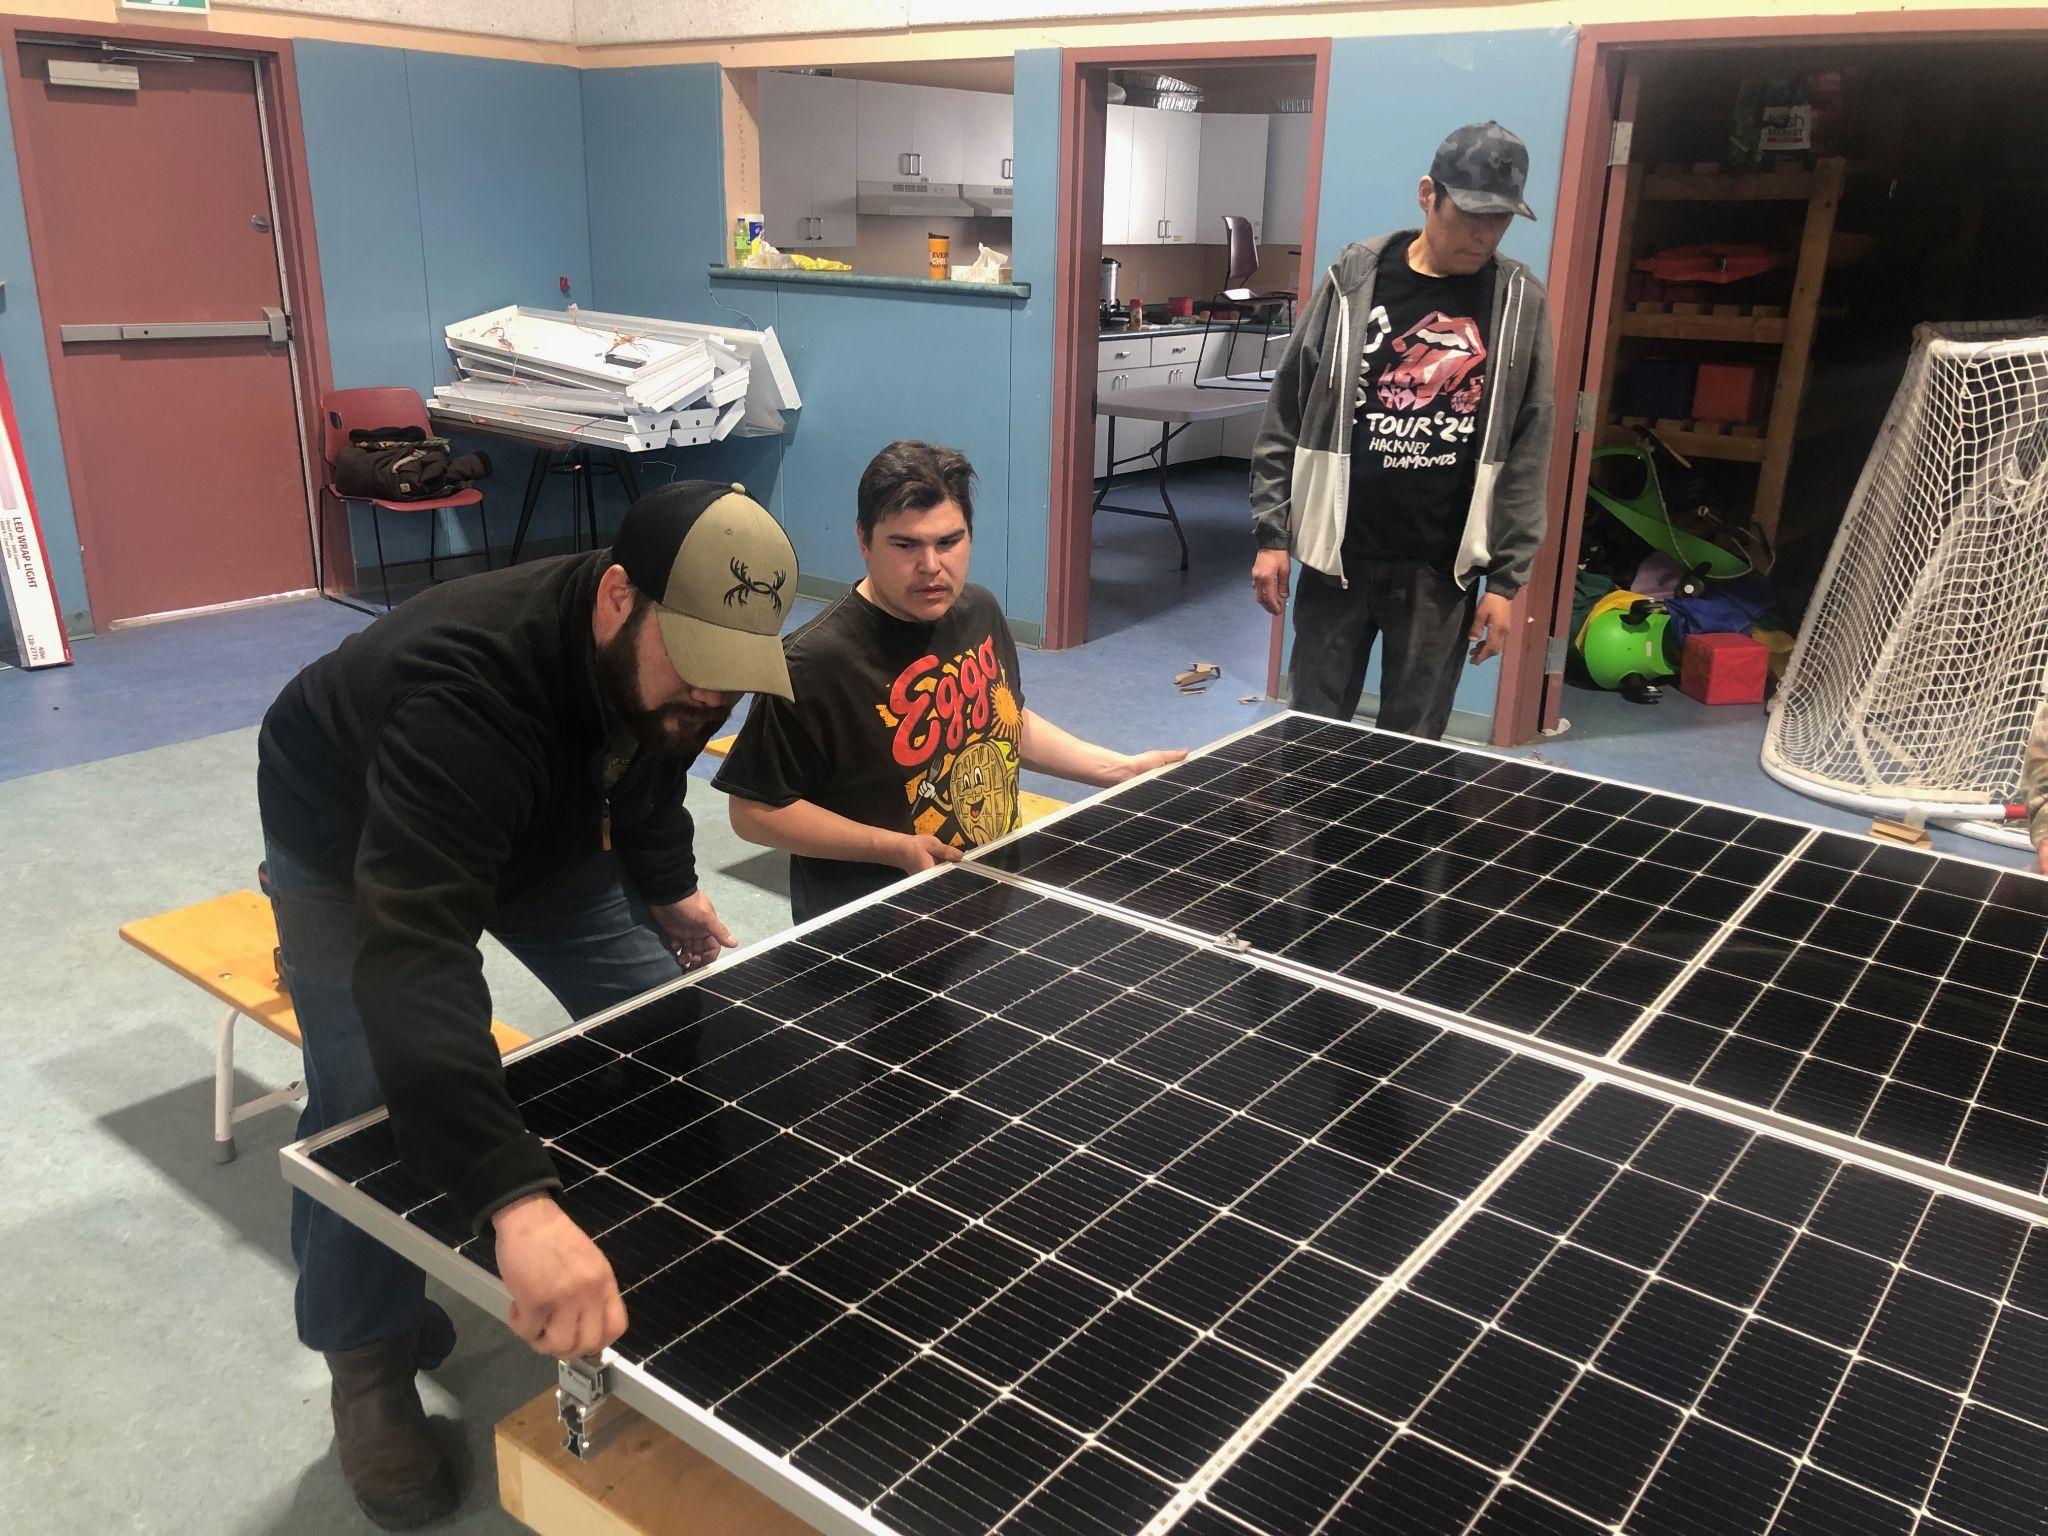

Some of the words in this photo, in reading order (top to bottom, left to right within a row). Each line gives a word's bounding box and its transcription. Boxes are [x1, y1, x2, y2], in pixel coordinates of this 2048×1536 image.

[1366, 413, 1433, 439] TOUR
[1369, 437, 1430, 455] HACKNEY
[1383, 452, 1457, 470] DIAMONDS
[13, 517, 24, 533] LED
[18, 535, 31, 561] WRAP
[24, 563, 38, 588] LIGHT
[889, 635, 998, 767] Eggo
